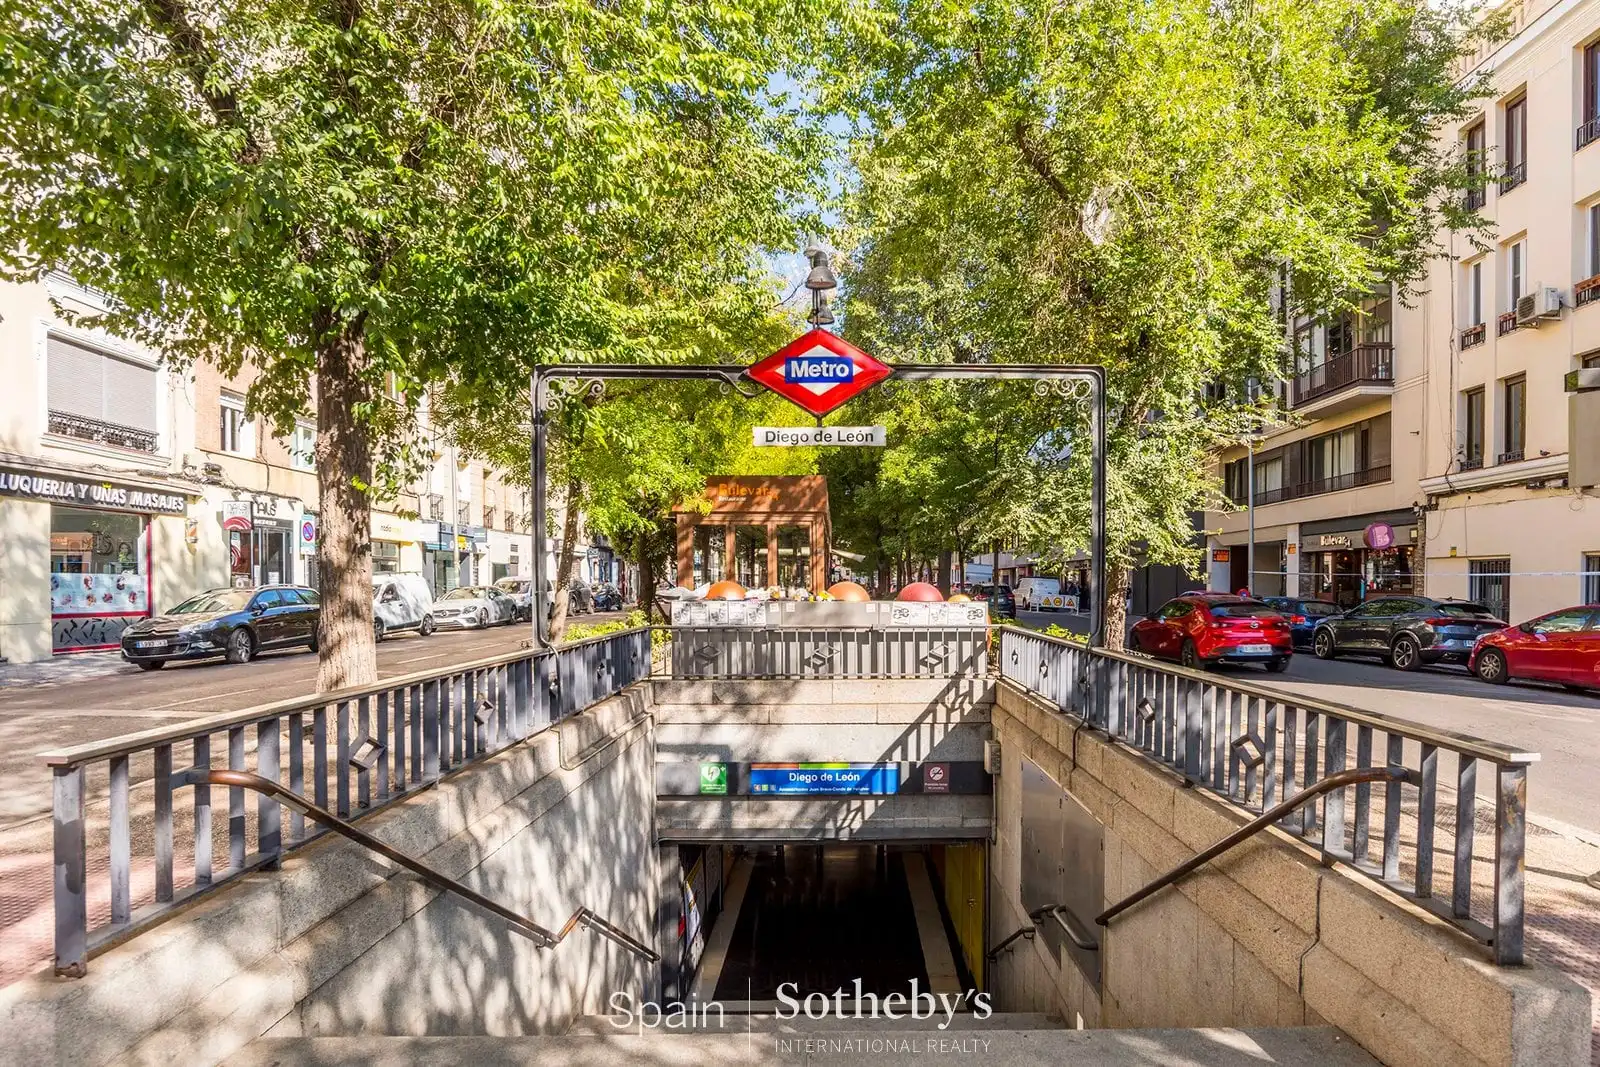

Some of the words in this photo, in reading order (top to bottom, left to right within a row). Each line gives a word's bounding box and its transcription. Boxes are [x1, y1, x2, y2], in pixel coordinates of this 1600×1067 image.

[791, 360, 849, 377] Metro
[765, 431, 809, 445] Diego
[814, 430, 832, 442] de
[837, 430, 874, 442] León
[78, 483, 88, 499] Y
[130, 491, 184, 511] MASAJES
[719, 483, 769, 496] Bulevar
[789, 772, 818, 783] Diego
[820, 772, 833, 782] de
[835, 772, 860, 782] León
